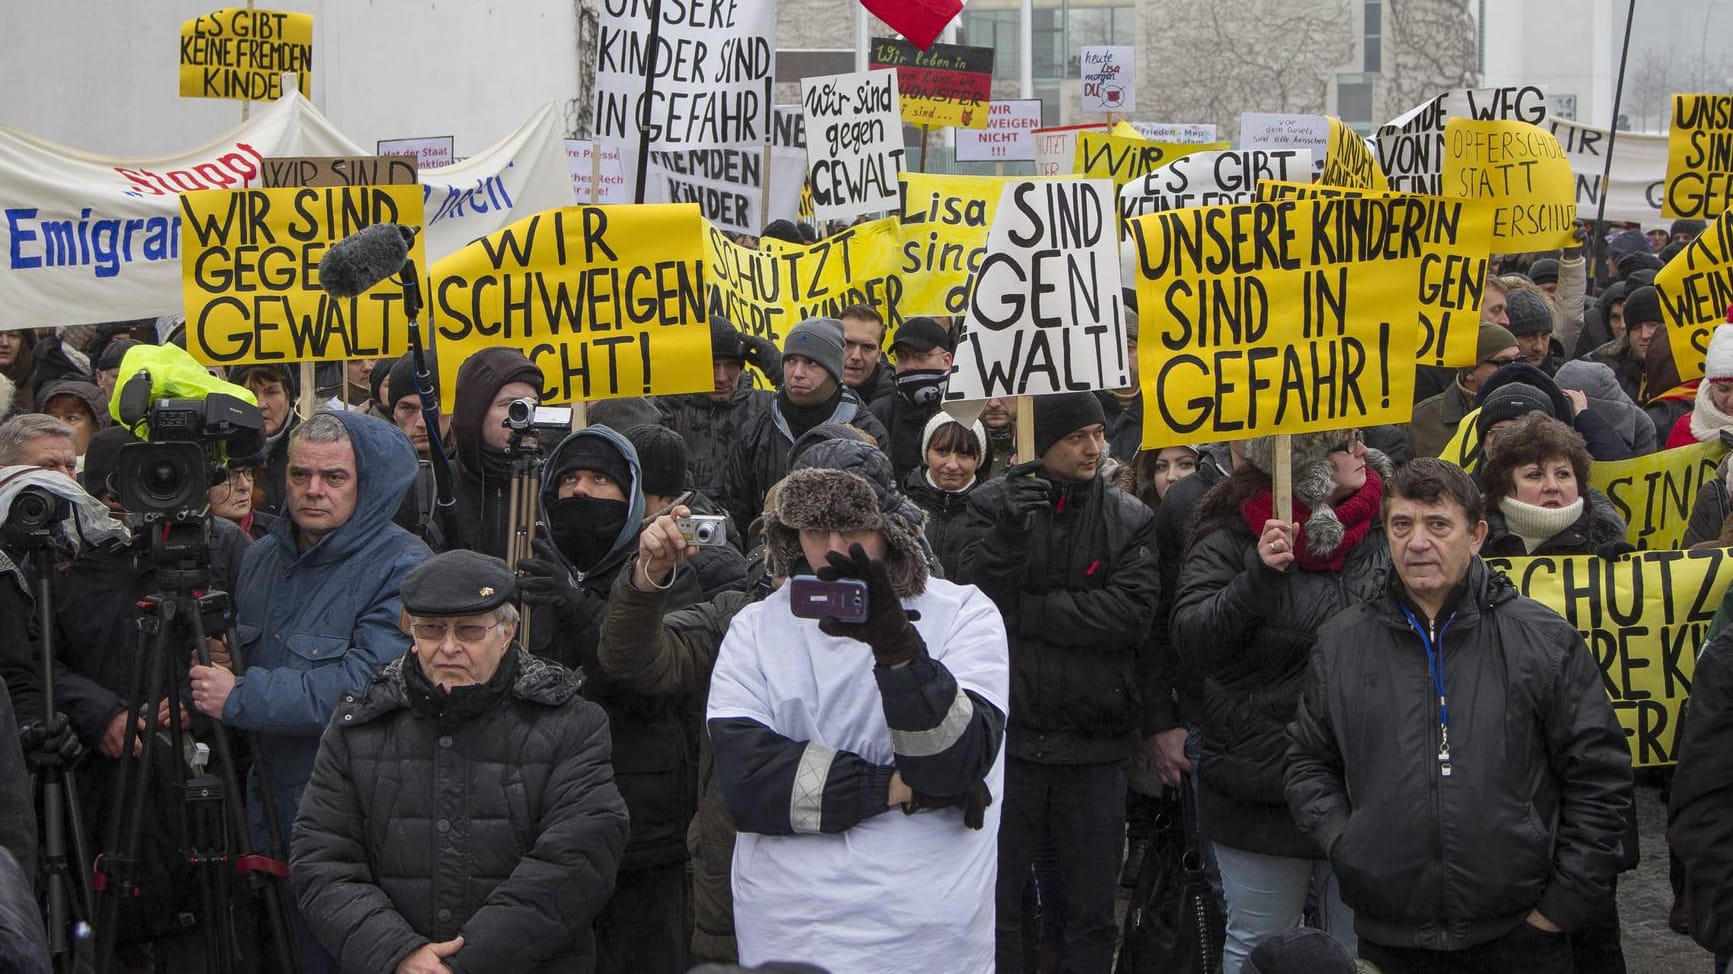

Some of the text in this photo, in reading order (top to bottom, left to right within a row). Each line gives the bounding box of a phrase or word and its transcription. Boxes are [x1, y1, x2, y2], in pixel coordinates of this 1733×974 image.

[195, 11, 287, 40] ES GIBT
[180, 35, 312, 72] KEINE FREMDEN
[598, 25, 771, 83] KINDER SIND
[915, 51, 949, 67] leben
[954, 57, 967, 70] in
[1085, 50, 1113, 64] heute
[1101, 63, 1120, 73] Lisa
[596, 76, 773, 142] IN GEFAHR!
[853, 74, 892, 114] sind
[1676, 96, 1733, 130] UNS
[422, 147, 448, 157] Staat
[825, 119, 884, 158] gegen
[978, 133, 1019, 143] NICHT
[991, 147, 1006, 156] !!!
[1376, 133, 1430, 176] VON
[1685, 130, 1733, 172] SIN
[417, 160, 451, 169] nktion
[811, 149, 905, 206] GEWALT
[1144, 157, 1190, 195] ES
[1214, 149, 1297, 192] GIBT
[1459, 160, 1538, 197] STATT
[180, 190, 276, 247] WIR
[288, 188, 400, 242] SIND
[900, 182, 986, 226] Lisa
[1008, 182, 1103, 249] SIND
[480, 207, 618, 270] WIR
[1133, 200, 1301, 280] UNSERE
[1310, 199, 1427, 266] KINDER
[194, 242, 333, 294] GEGE
[710, 229, 856, 303] SCHÜTZT
[1419, 253, 1486, 312] GEN
[437, 260, 706, 341] SCHWEIGEN
[971, 249, 1100, 331] GEN
[1161, 267, 1348, 350] SIND IN
[536, 332, 652, 401] CHT!
[944, 295, 1127, 398] EWALT!
[1157, 322, 1390, 434] GEFAHR!
